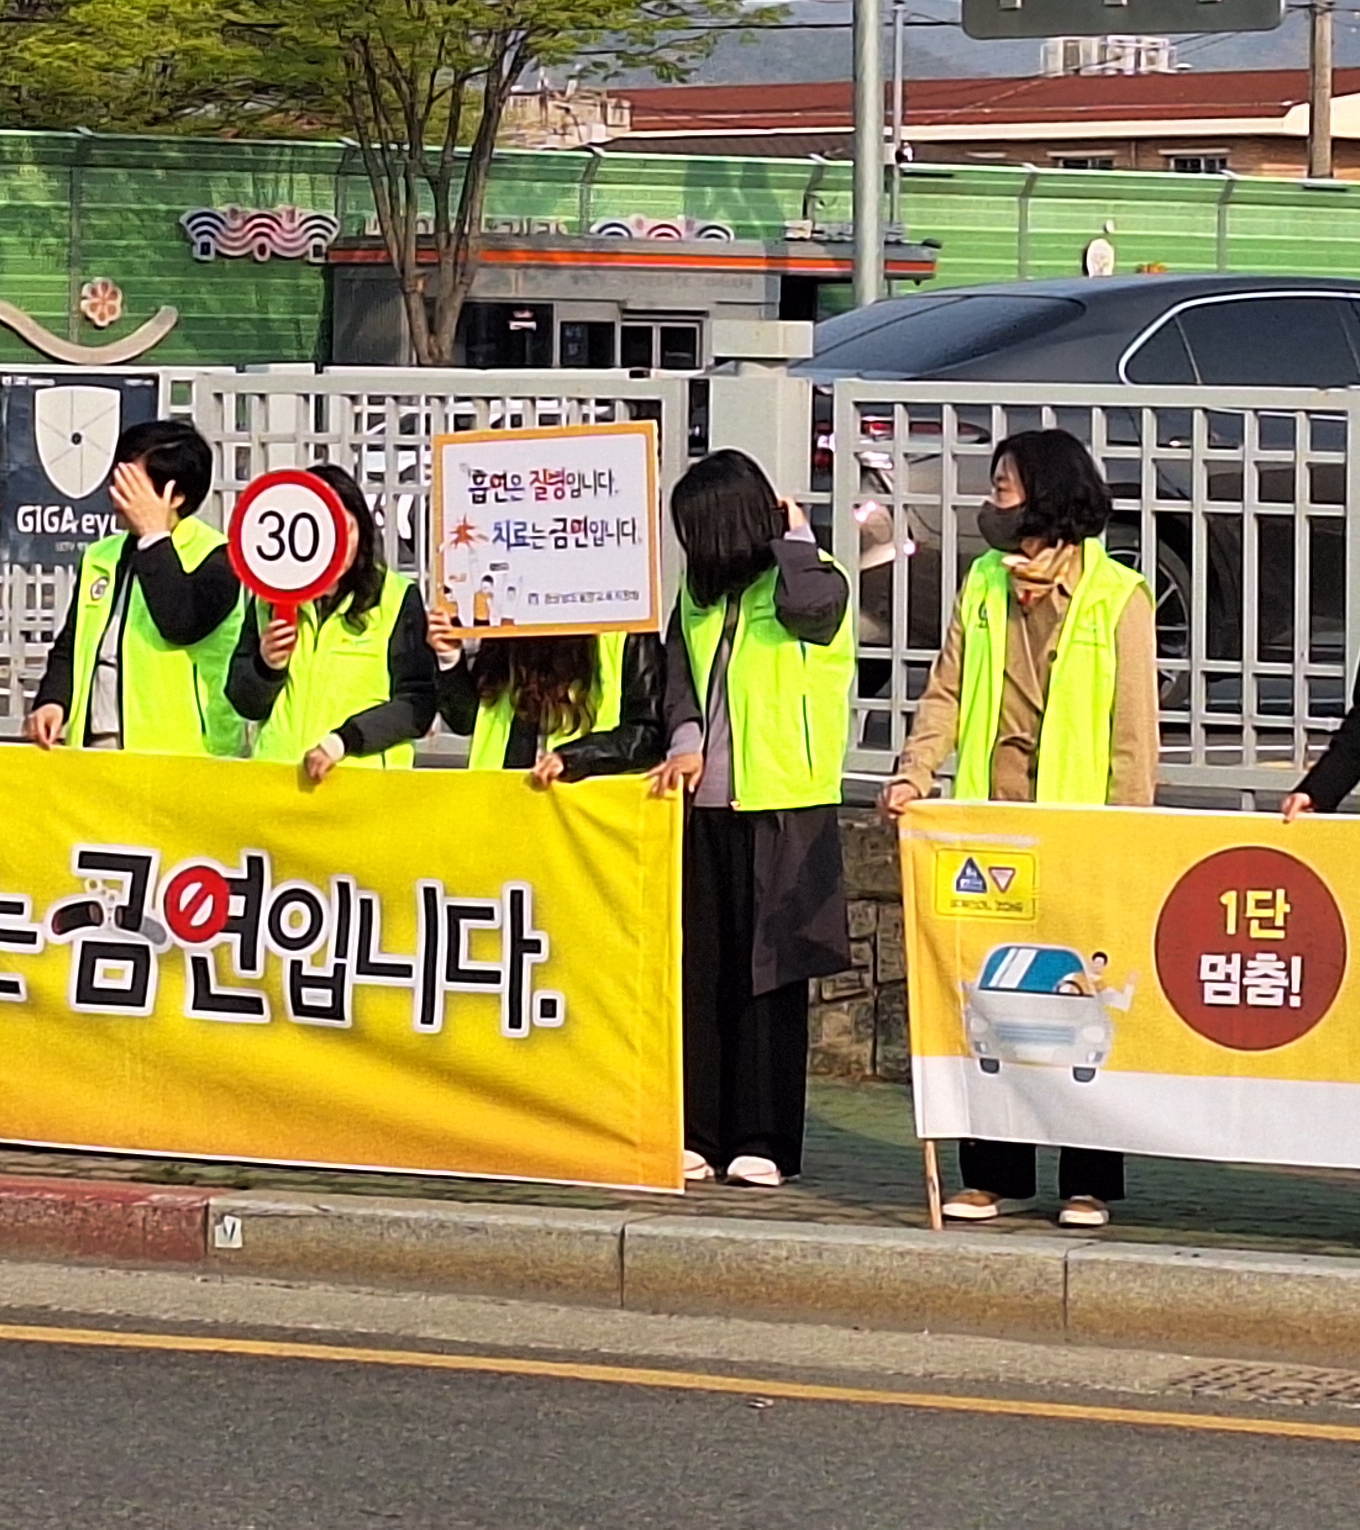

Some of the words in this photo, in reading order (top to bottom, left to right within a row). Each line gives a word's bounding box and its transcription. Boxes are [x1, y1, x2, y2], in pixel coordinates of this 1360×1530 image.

[468, 468, 525, 505] 흡연은
[529, 467, 620, 502] 질병입니다.
[17, 505, 79, 533] GIGA
[255, 510, 320, 563] 30
[492, 518, 547, 552] 치료는
[1219, 888, 1291, 939] 1단
[48, 850, 559, 1032] 금연입니다.
[1199, 952, 1302, 1008] 멈춤!
